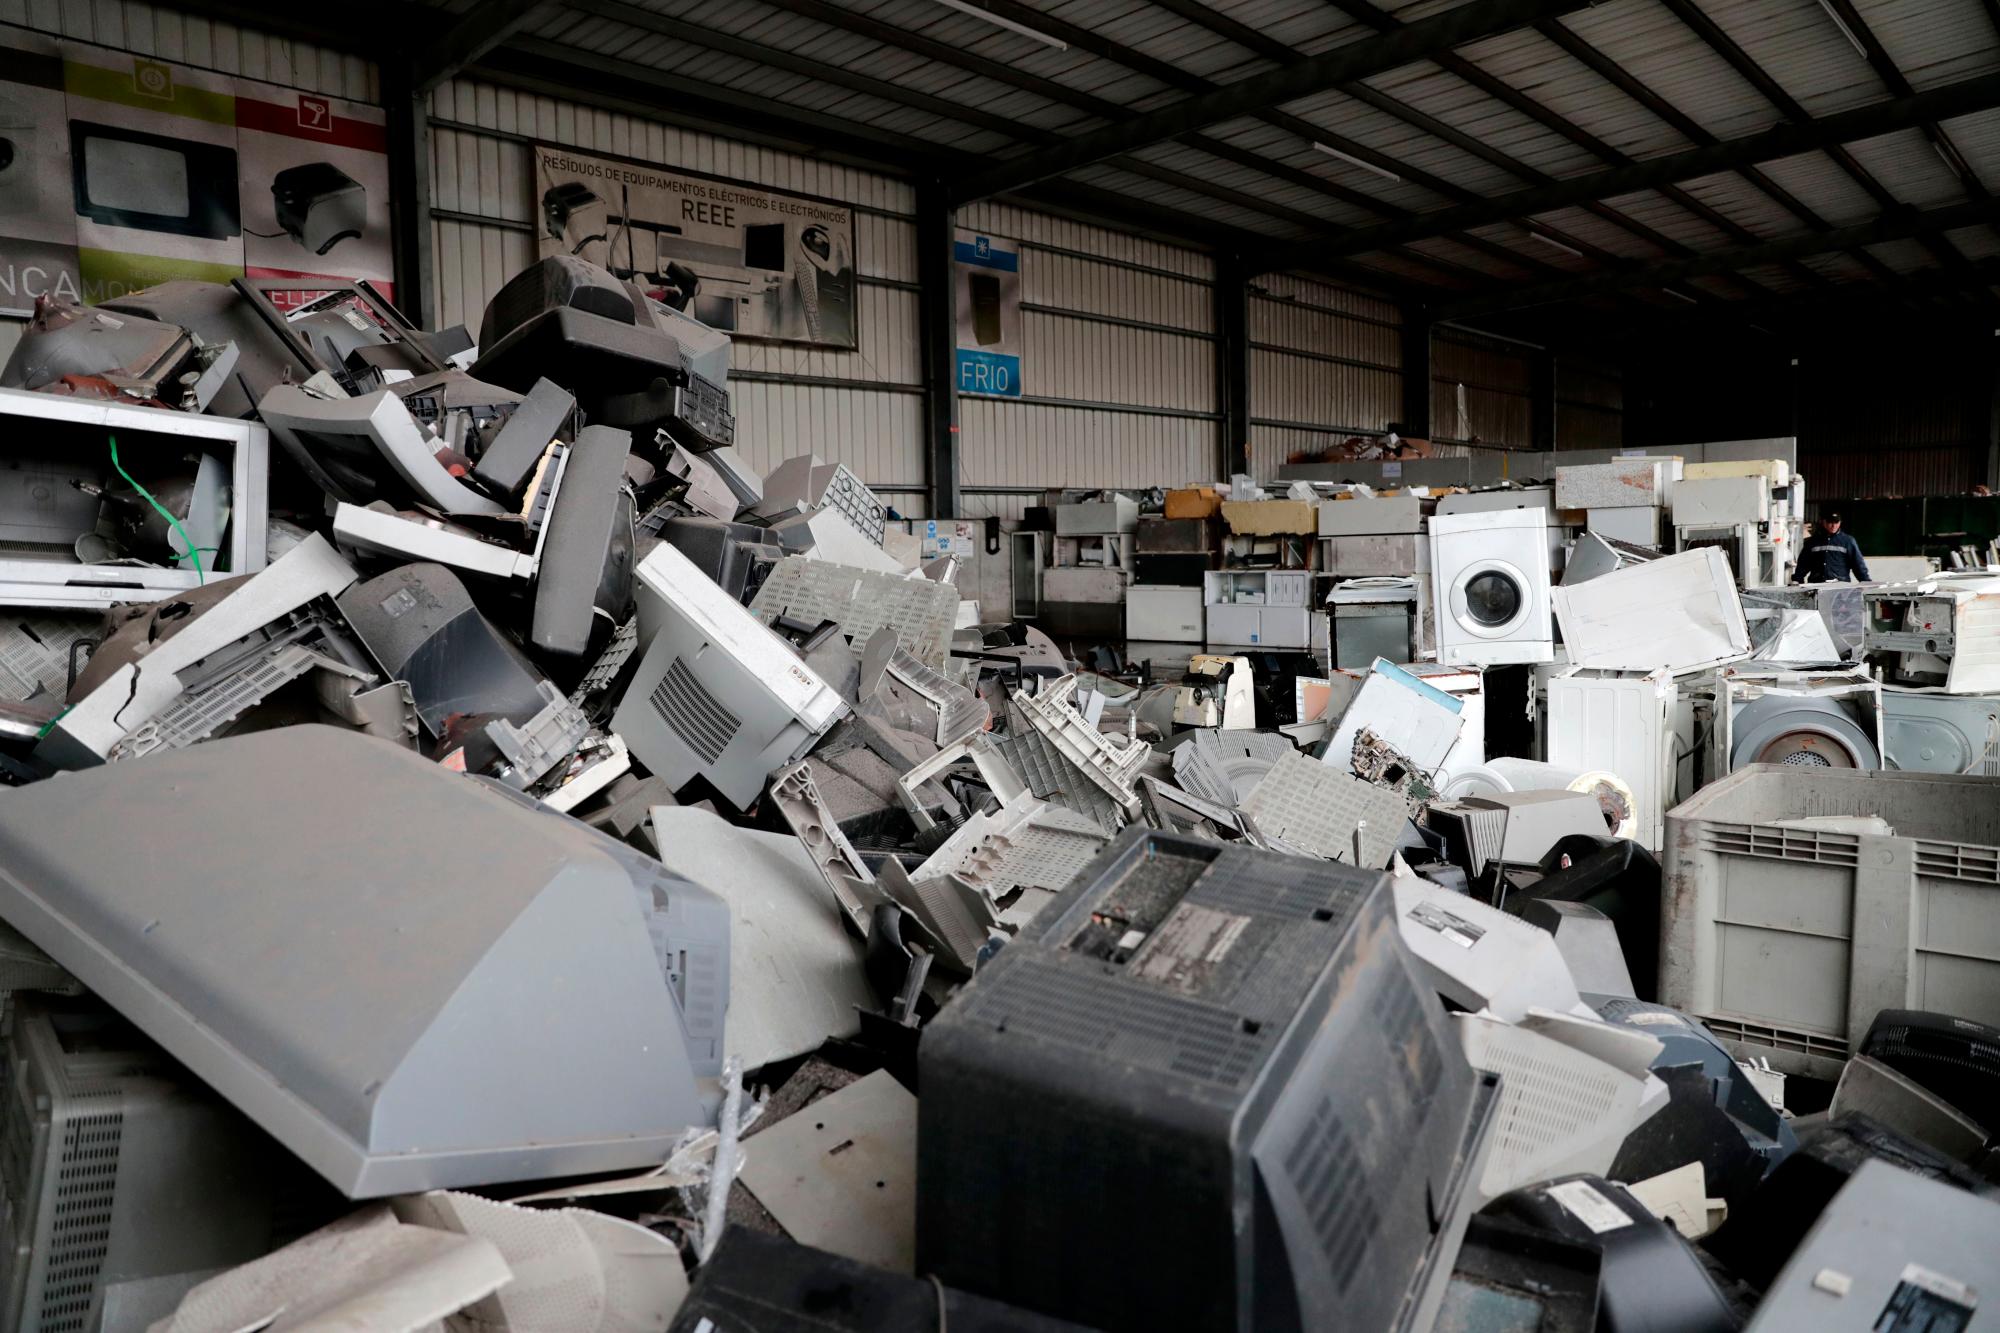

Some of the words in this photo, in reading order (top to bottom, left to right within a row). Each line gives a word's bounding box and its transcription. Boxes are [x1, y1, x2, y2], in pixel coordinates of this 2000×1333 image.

[544, 155, 602, 178] RESÍDUOS
[606, 168, 620, 180] DE
[623, 171, 706, 197] EQUIPAMENTOS
[709, 188, 769, 209] ELÉCTRICOS
[771, 200, 777, 211] E
[780, 202, 847, 224] ELECTRÓNICOS
[682, 199, 736, 228] REEE
[961, 362, 1009, 392] FRIO
